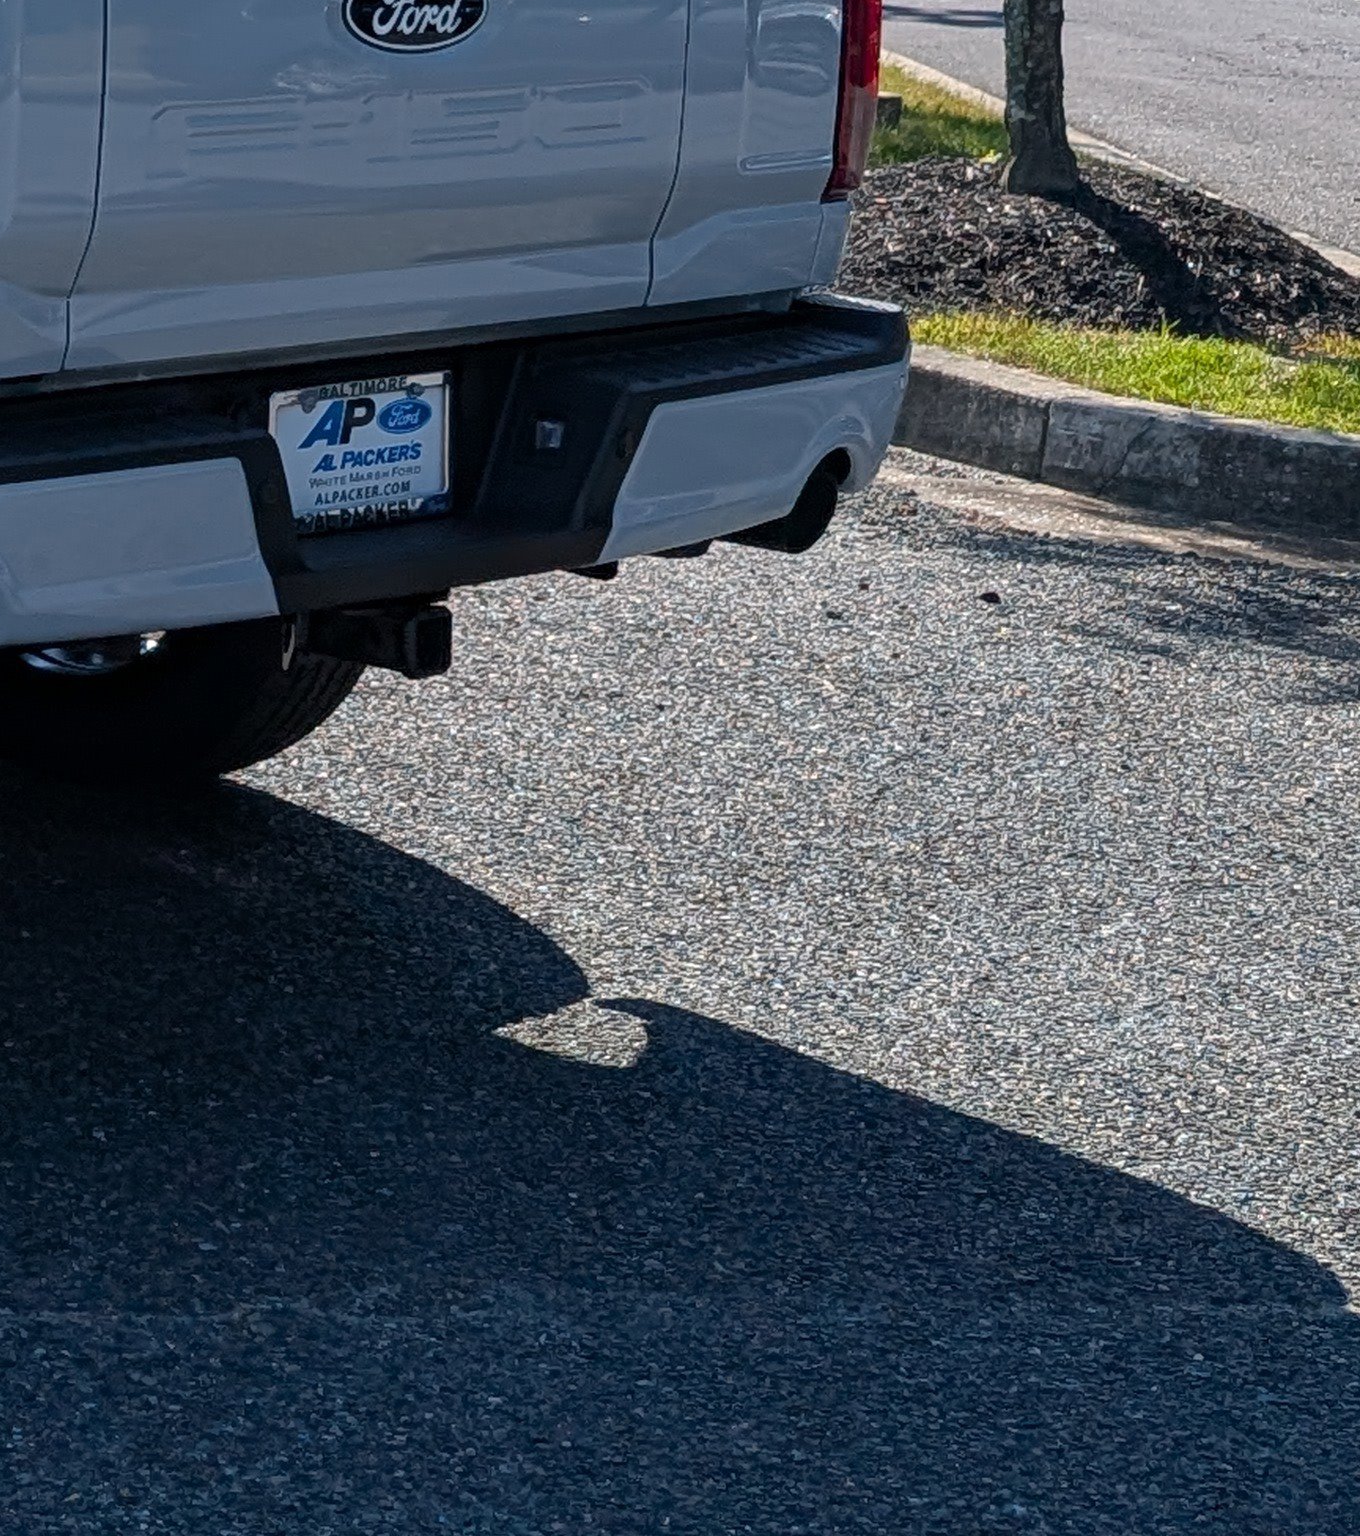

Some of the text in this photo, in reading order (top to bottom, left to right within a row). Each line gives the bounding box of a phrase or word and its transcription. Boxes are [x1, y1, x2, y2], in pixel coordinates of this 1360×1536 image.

[320, 376, 408, 398] BALTIMORE
[297, 396, 376, 450] AP
[311, 440, 422, 474] AL PACKER'S
[314, 480, 411, 507] ALPACKER.COM
